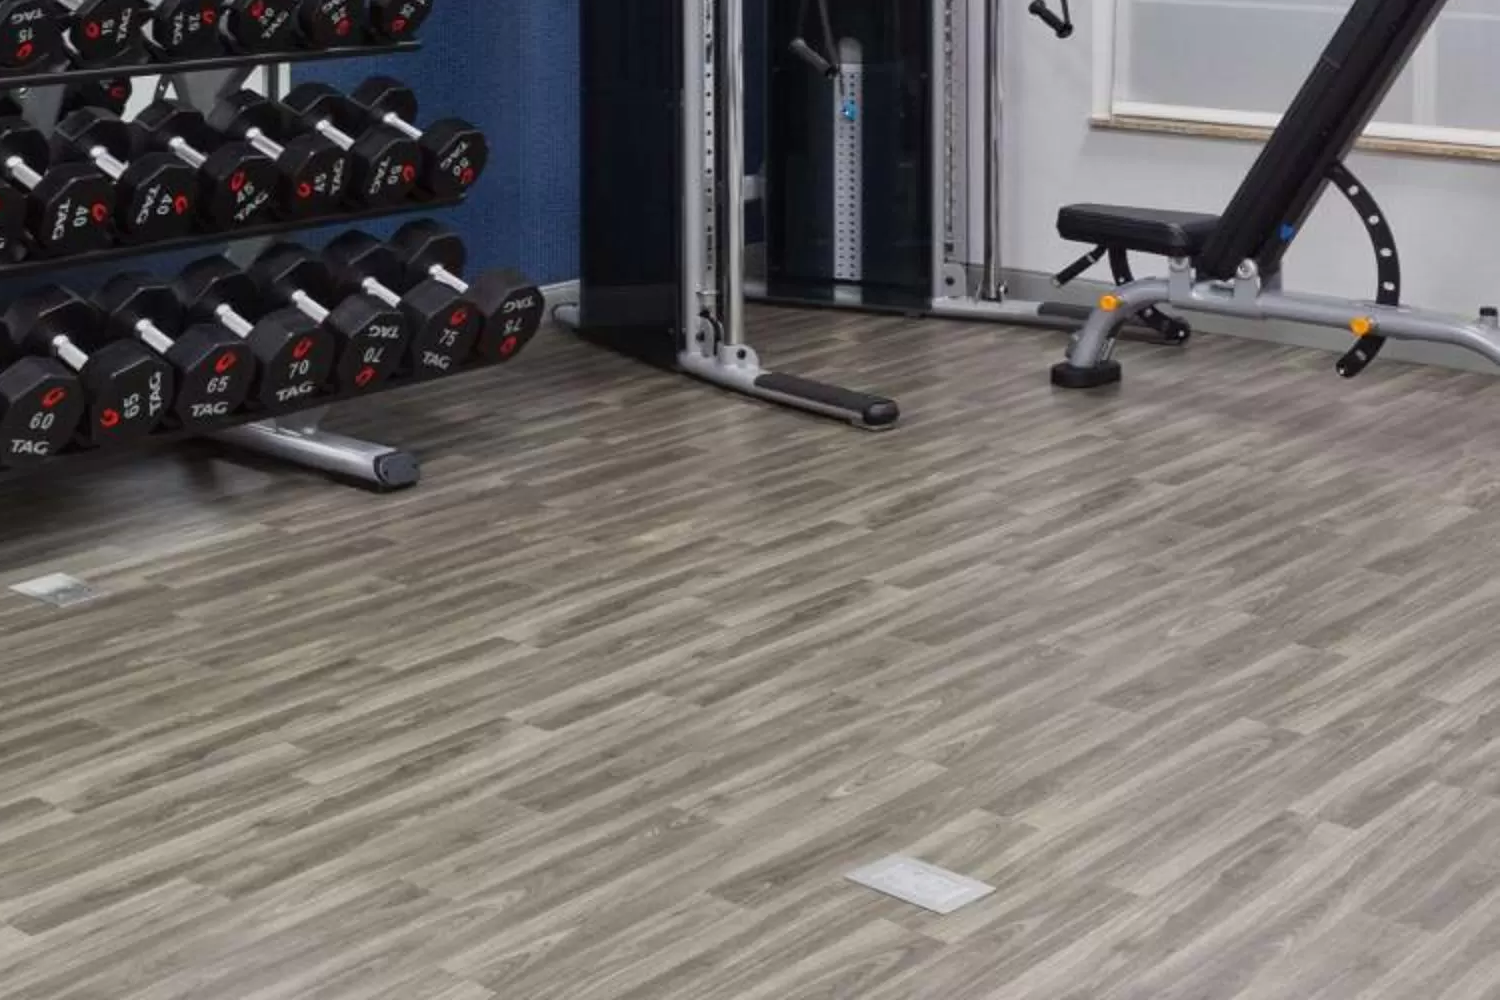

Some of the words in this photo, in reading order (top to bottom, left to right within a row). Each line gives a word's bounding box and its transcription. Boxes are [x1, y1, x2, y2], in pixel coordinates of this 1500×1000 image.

[11, 7, 45, 25] TAG
[115, 7, 132, 43] TAG
[261, 11, 289, 38] TAG
[18, 27, 33, 43] 15
[172, 11, 183, 45] TAG
[440, 141, 469, 169] TAG
[330, 157, 345, 196] TAG
[369, 156, 391, 195] TAG
[136, 184, 161, 225] TAG
[156, 193, 173, 216] 40
[233, 190, 269, 221] TAG
[52, 198, 71, 240] TAG
[73, 206, 89, 227] 40
[503, 296, 534, 313] TAG
[368, 325, 399, 339] TAG
[439, 329, 460, 346] 75
[363, 347, 385, 364] 70
[423, 351, 451, 370] TAG
[289, 359, 310, 380] 70
[149, 371, 162, 417] TAG
[206, 375, 230, 393] 65
[275, 381, 315, 402] TAG
[123, 393, 139, 419] 65
[191, 401, 229, 417] TAG
[28, 412, 55, 430] 60
[11, 439, 50, 455] TAG
